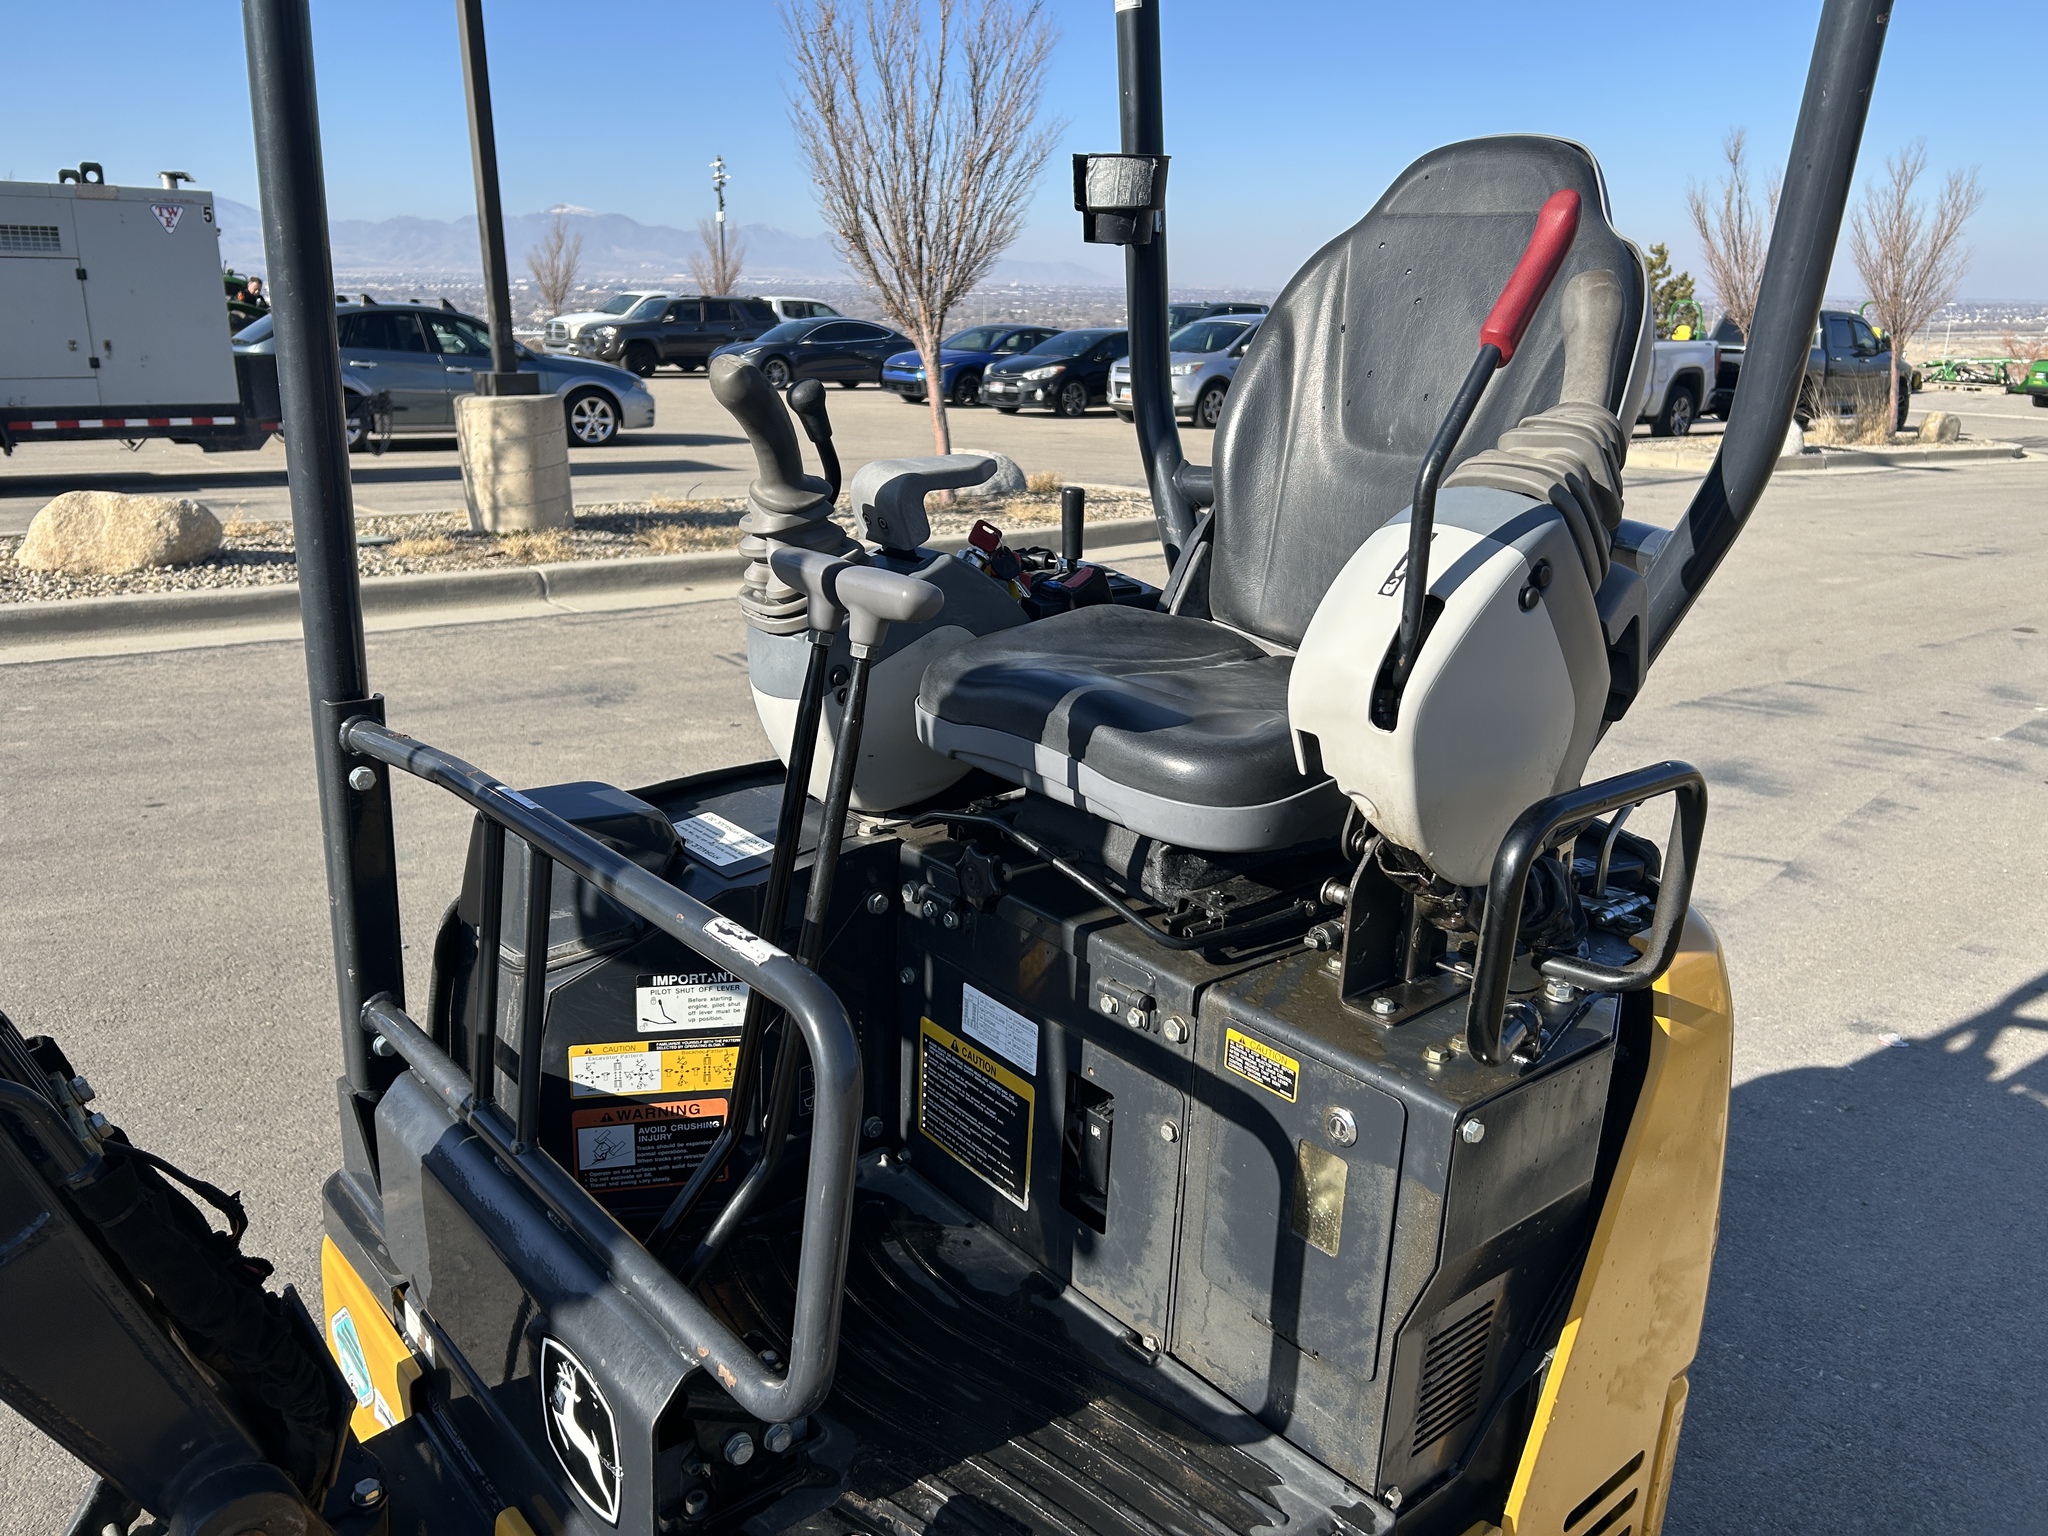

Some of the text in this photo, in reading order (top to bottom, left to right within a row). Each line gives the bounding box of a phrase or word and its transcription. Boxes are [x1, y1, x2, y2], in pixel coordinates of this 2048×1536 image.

[203, 206, 213, 223] 5
[652, 971, 735, 986] IMPORTANT
[716, 984, 740, 992] LEVER
[602, 1044, 636, 1053] CAUTION
[1250, 1040, 1288, 1066] CAUTION
[960, 1045, 998, 1078] CAUTION
[616, 1103, 700, 1122] WARNING
[638, 1120, 720, 1135] AVOID CRUSHING
[638, 1133, 672, 1142] INJURY
